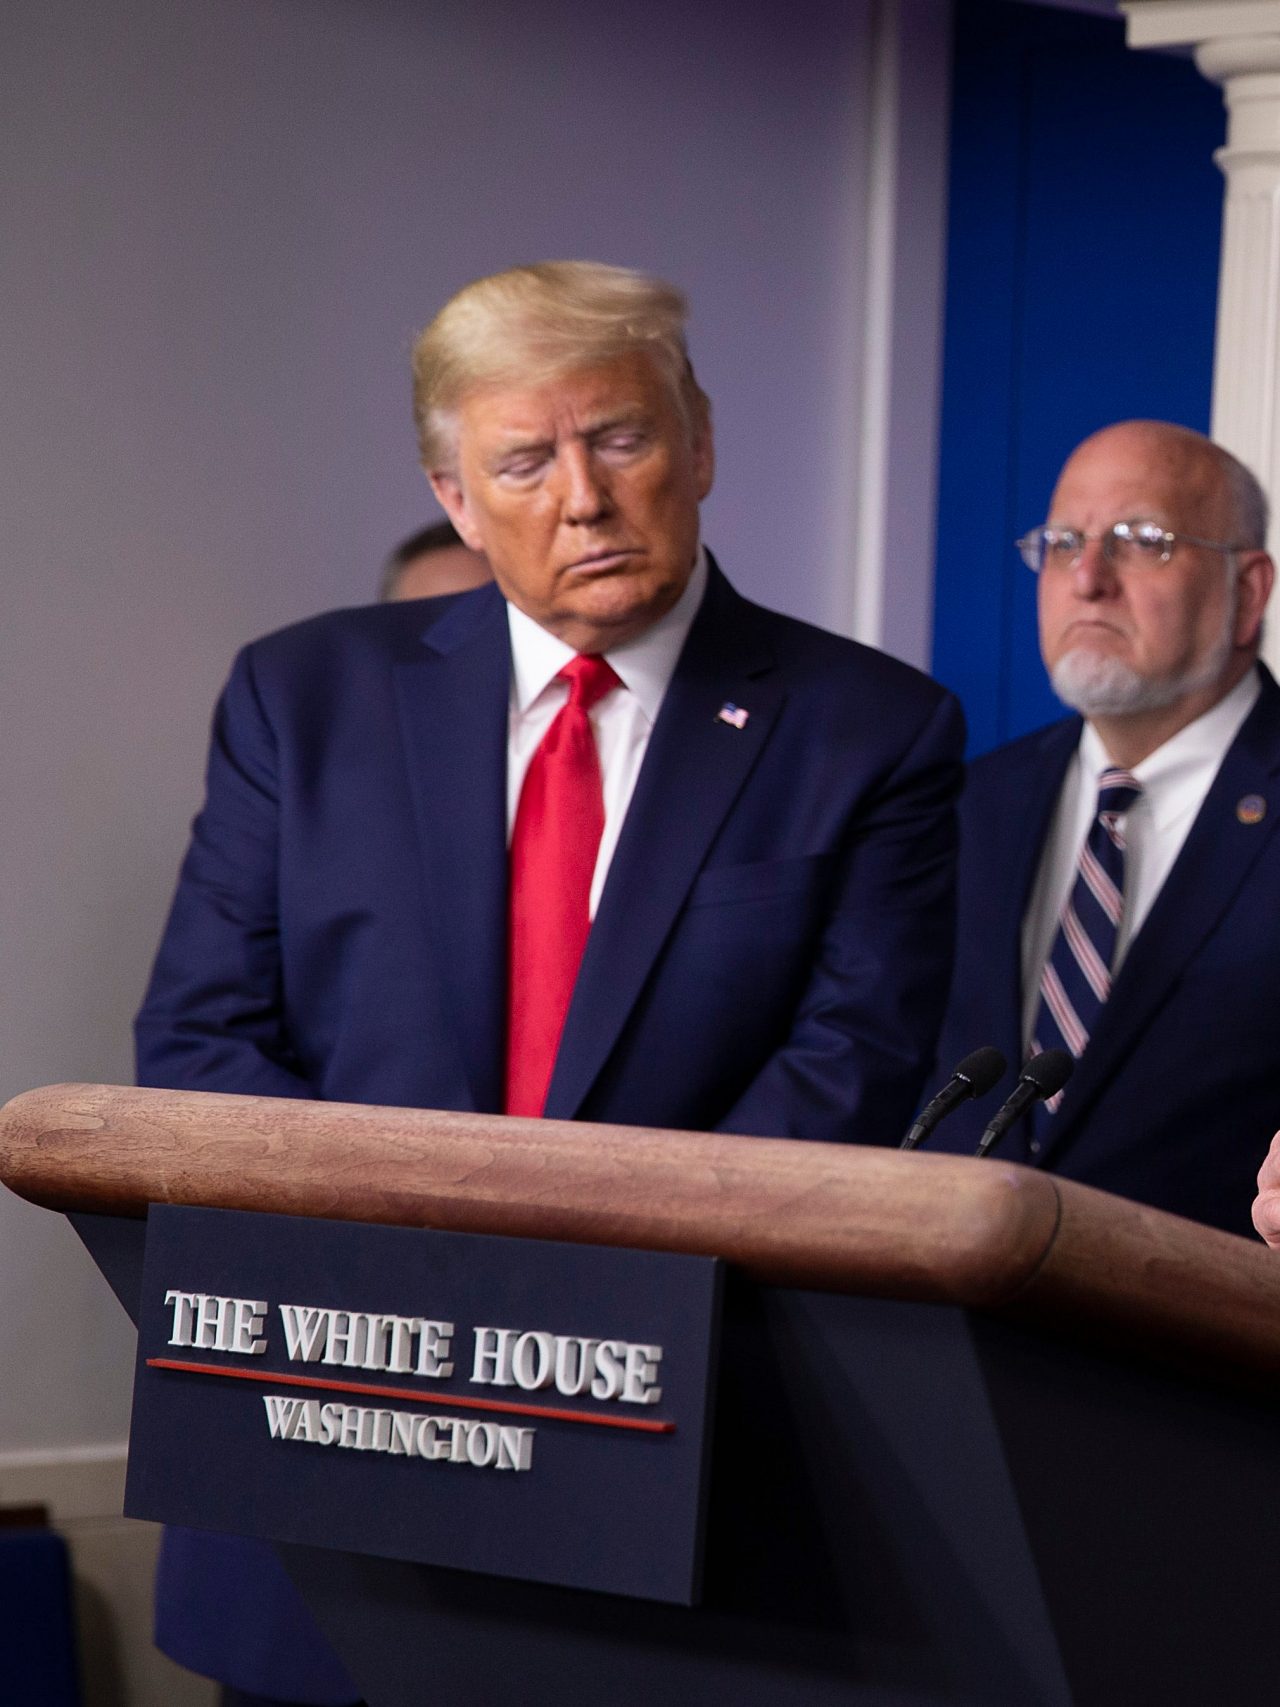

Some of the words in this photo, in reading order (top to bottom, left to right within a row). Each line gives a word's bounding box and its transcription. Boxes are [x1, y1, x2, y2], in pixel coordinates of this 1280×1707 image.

[164, 1290, 268, 1354] THE
[279, 1304, 454, 1378] WHITE
[470, 1326, 663, 1403] HOUSE
[263, 1396, 536, 1471] WASHINGTON
